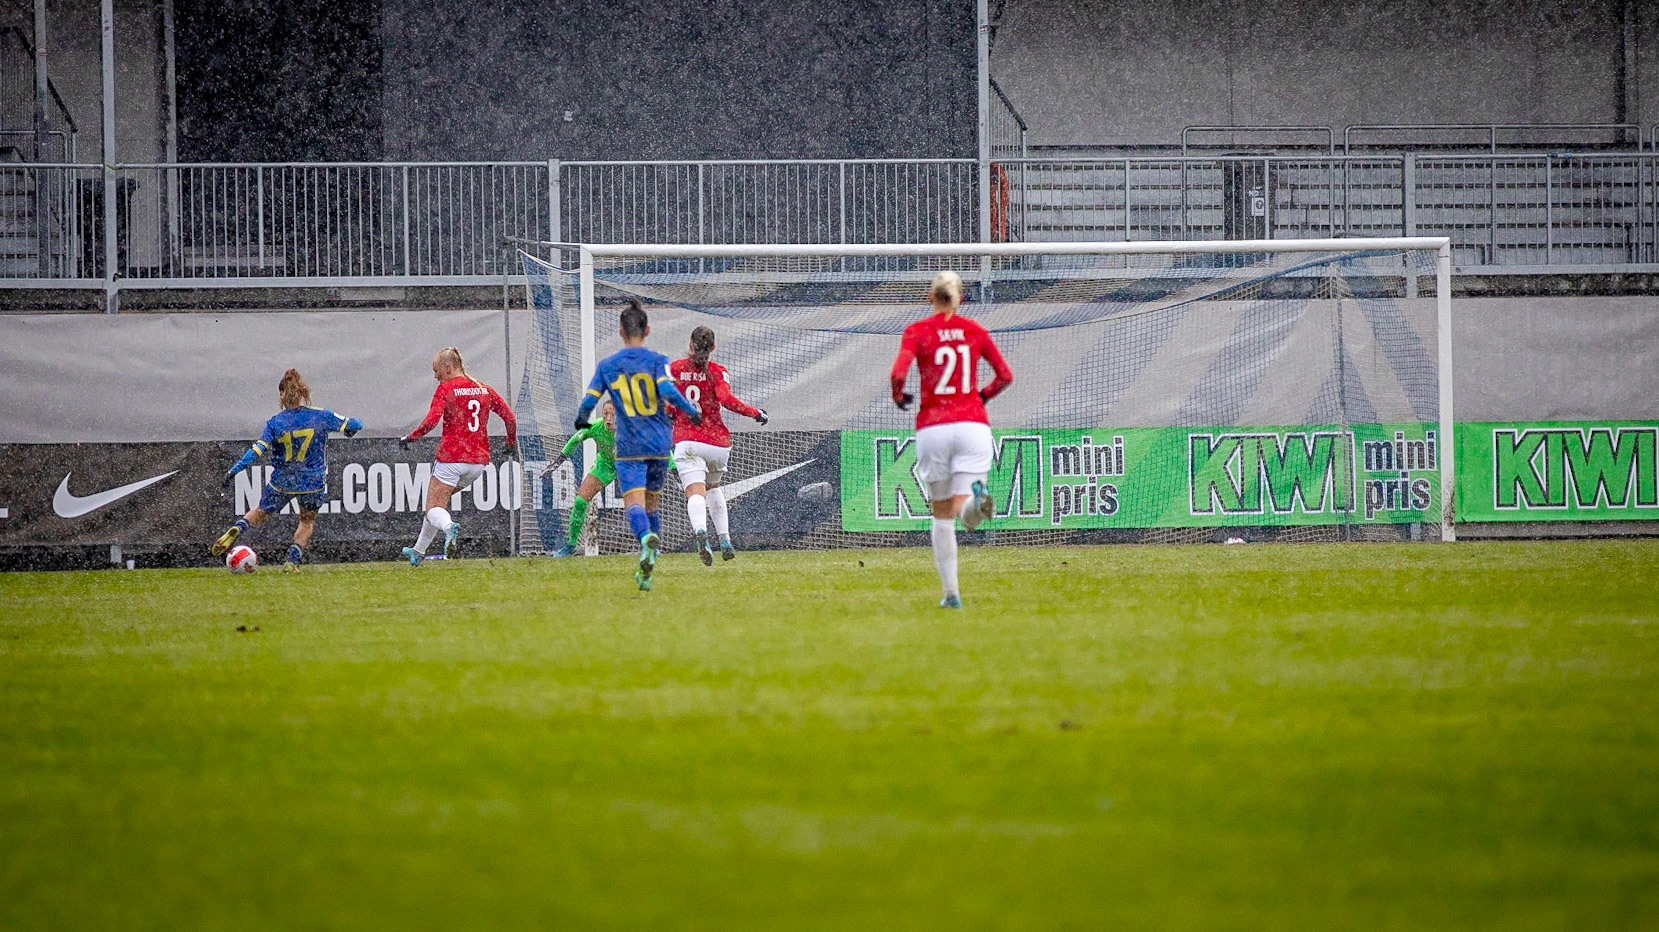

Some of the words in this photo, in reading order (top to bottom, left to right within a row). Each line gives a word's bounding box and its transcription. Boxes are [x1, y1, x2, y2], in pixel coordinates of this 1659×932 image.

[934, 344, 971, 395] 21
[467, 399, 481, 433] 3
[610, 372, 658, 417] 10
[278, 428, 315, 463] 17
[1050, 435, 1124, 477] mini
[1363, 430, 1436, 473] mini
[1493, 427, 1659, 510] KIWI
[1188, 431, 1356, 516] KIWI
[1364, 471, 1431, 521] pris
[1051, 475, 1120, 526] pris
